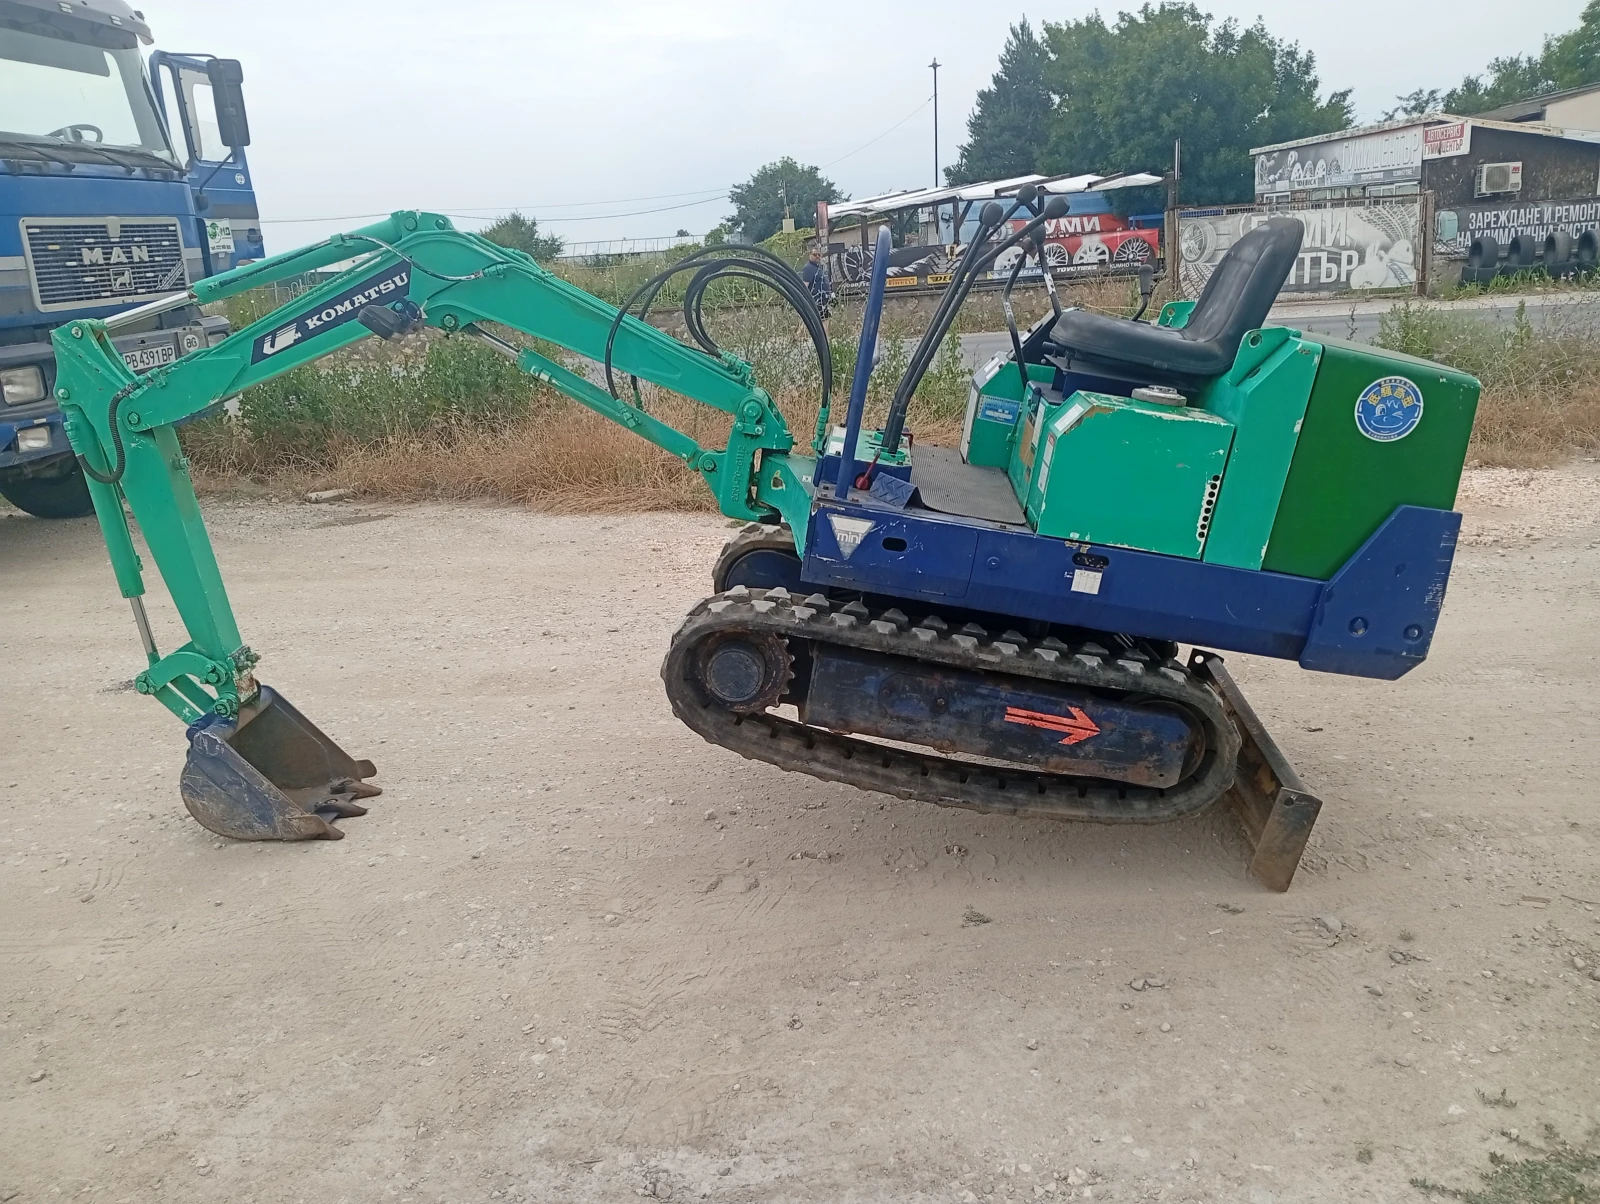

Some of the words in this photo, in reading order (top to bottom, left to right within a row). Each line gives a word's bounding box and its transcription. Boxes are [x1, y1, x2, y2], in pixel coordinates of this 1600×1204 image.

[1426, 125, 1461, 141] АВТОСЕРВИЗ
[1027, 216, 1101, 236] УМИ
[1469, 208, 1541, 229] ЗАРЕЖДАНЕ
[1543, 206, 1552, 223] И
[1456, 231, 1472, 248] НА
[81, 246, 149, 265] MAN
[304, 272, 408, 330] KOMATSU
[186, 337, 198, 348] BG
[140, 349, 160, 367] 4391
[836, 531, 863, 545] mini
